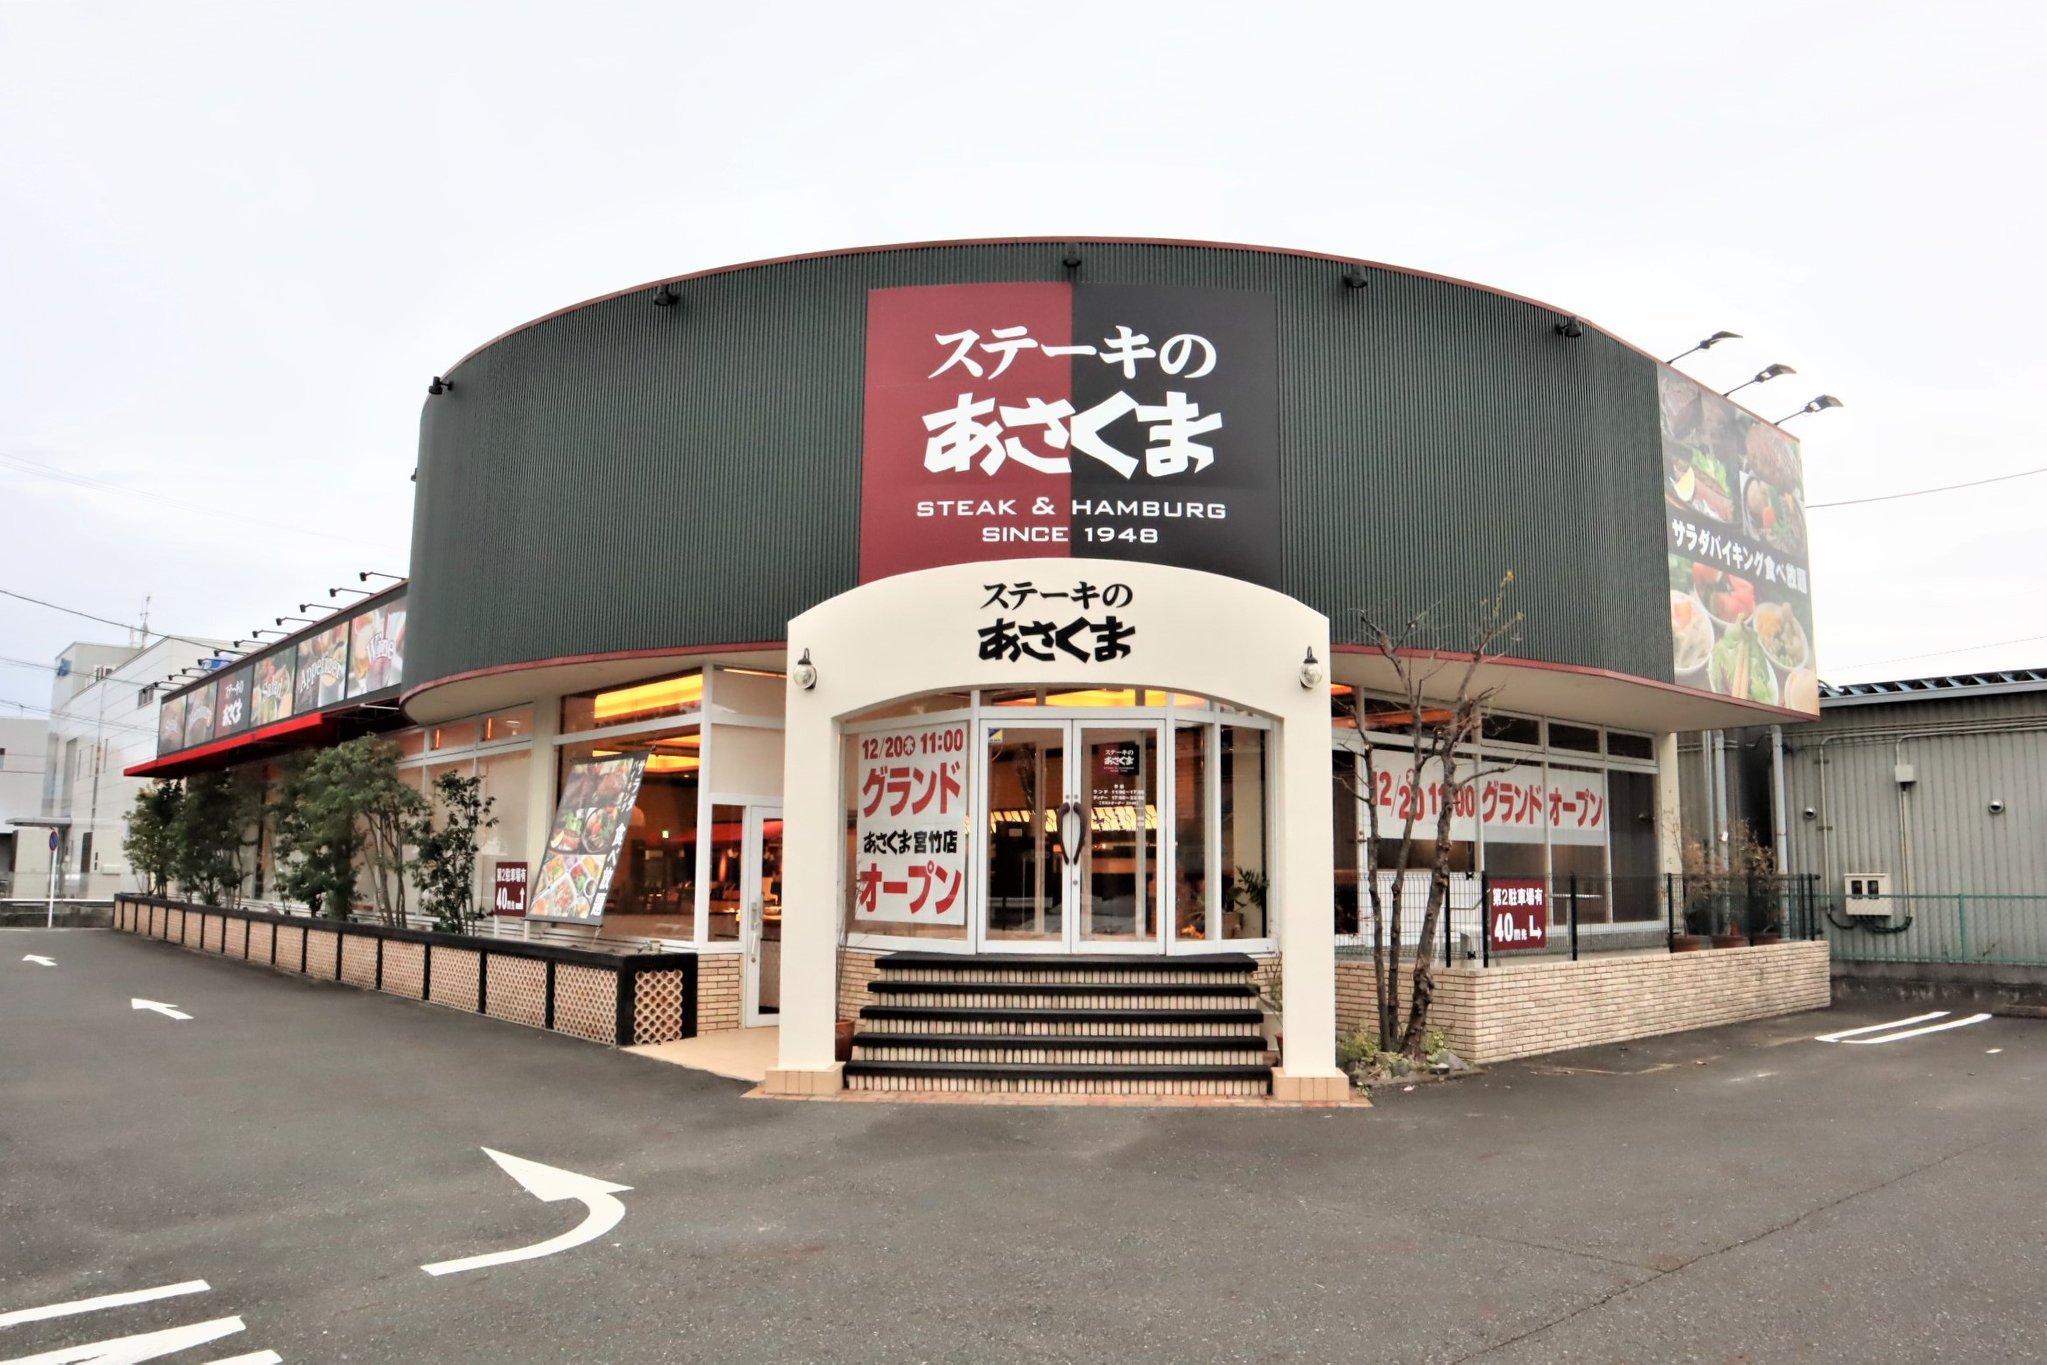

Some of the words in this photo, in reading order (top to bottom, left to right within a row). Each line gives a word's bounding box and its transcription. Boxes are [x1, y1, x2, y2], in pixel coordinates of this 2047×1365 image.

[927, 325, 1217, 381] ステーキの
[921, 390, 1223, 480] あさくま
[916, 500, 1017, 517] STEAK
[1031, 496, 1056, 516] &
[1071, 500, 1227, 519] HAMBURG
[982, 526, 1069, 543] SINCE
[1084, 527, 1159, 544] 1948
[979, 581, 1135, 611] ステーキの
[977, 616, 1136, 663] あさくま
[300, 654, 342, 693] Appetizer
[921, 728, 964, 754] 11:00
[862, 761, 961, 818] グランド
[1482, 780, 1543, 824] グランド
[1548, 787, 1603, 827] オープン
[859, 860, 962, 915] オープン
[1492, 887, 1543, 906] 第2駐車場有
